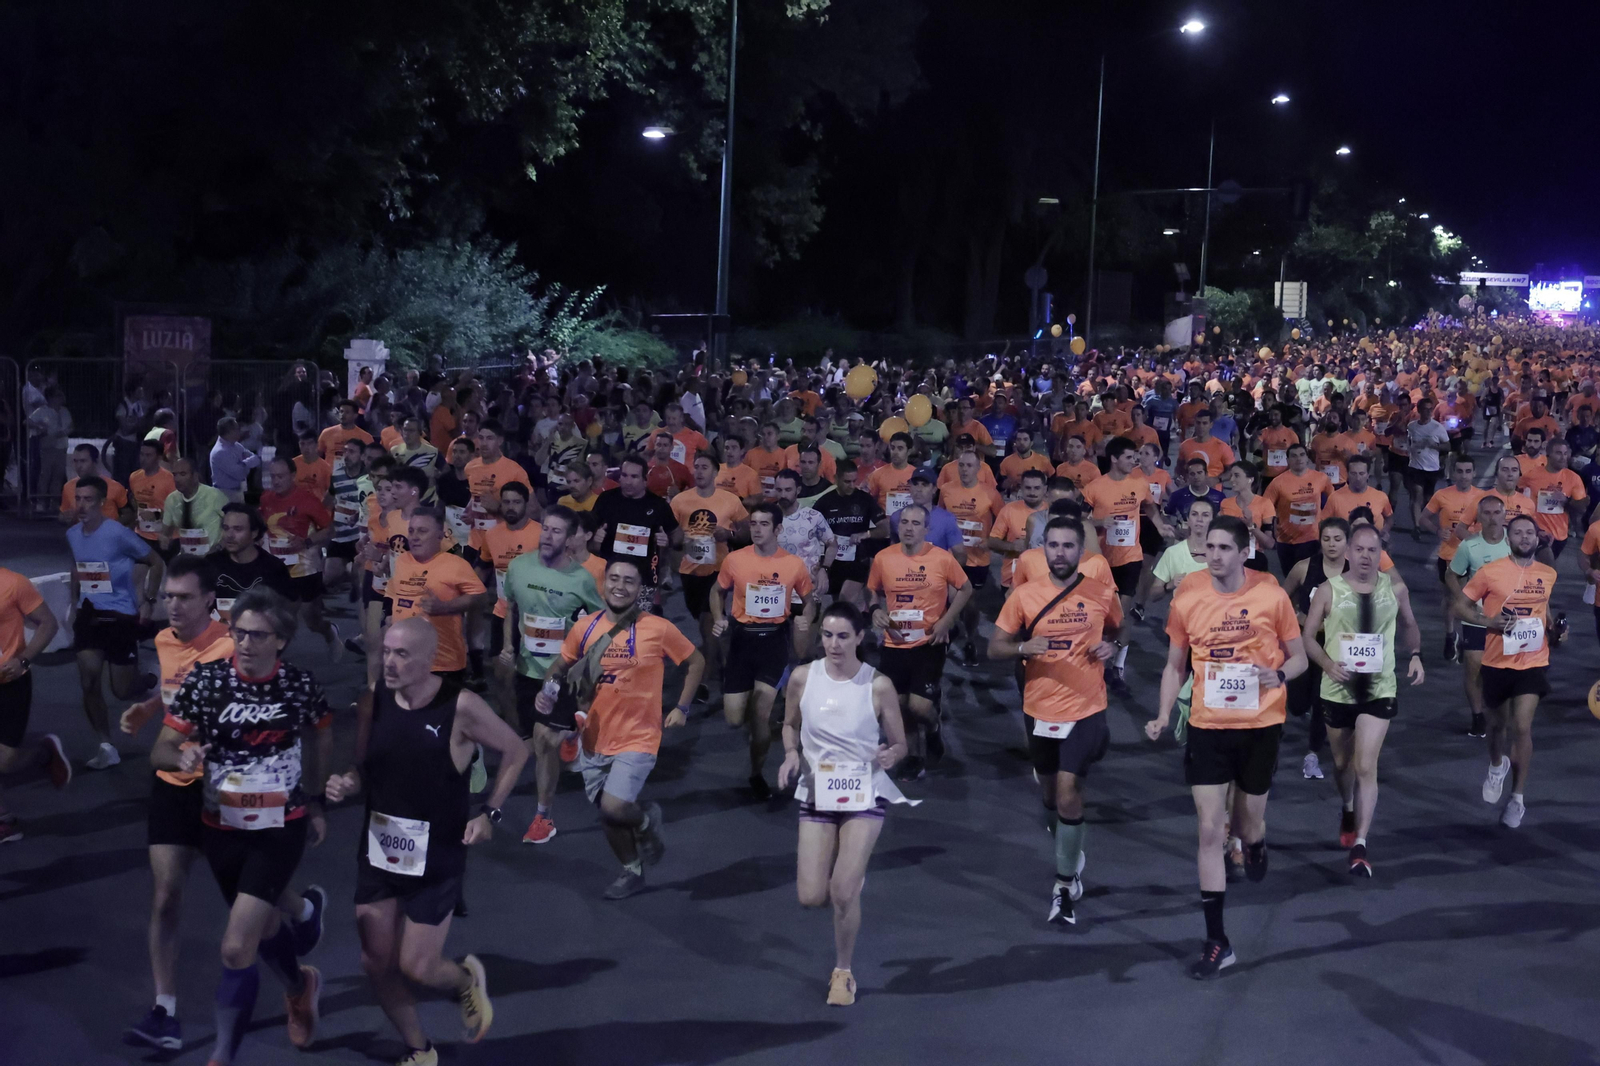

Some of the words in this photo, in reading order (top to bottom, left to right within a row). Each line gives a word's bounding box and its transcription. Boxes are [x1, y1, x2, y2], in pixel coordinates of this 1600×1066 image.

[142, 330, 194, 350] LUZIA
[1115, 528, 1130, 536] 8036
[627, 535, 639, 544] 531
[754, 595, 779, 605] 21616
[534, 629, 550, 638] 581
[1512, 629, 1537, 641] 16079
[1348, 646, 1376, 658] 12453
[1219, 678, 1246, 691] 2533
[218, 702, 288, 724] CORRE
[827, 778, 861, 790] 20802
[240, 794, 263, 808] 601
[379, 833, 414, 853] 20800
